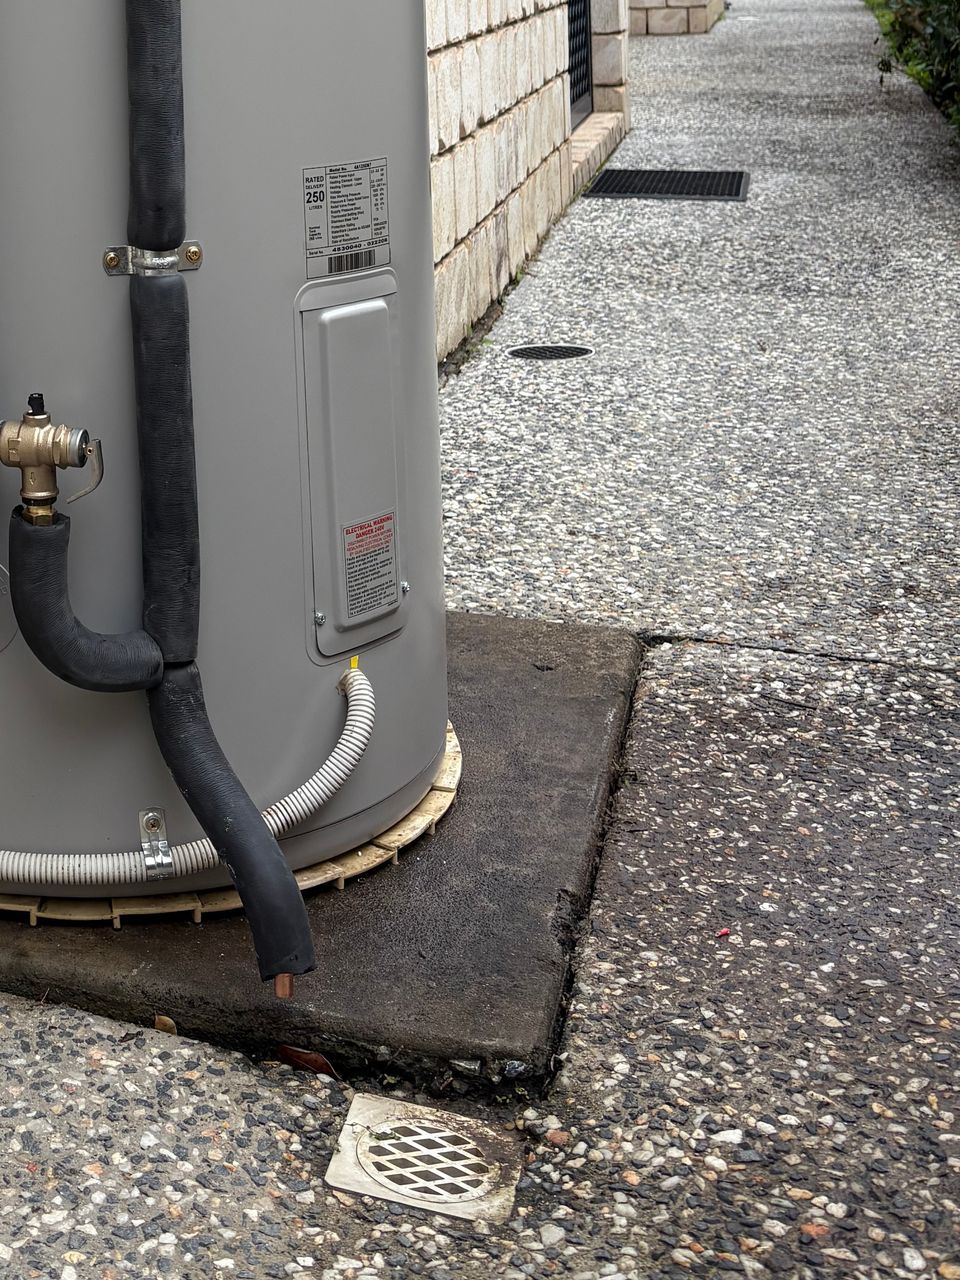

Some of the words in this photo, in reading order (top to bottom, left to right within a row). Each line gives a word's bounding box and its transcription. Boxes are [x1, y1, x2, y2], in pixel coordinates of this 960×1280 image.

[305, 190, 325, 203] 250
[345, 522, 372, 535] ELECTRICAL
[373, 515, 392, 526] WARNING
[356, 528, 374, 539] DANGER
